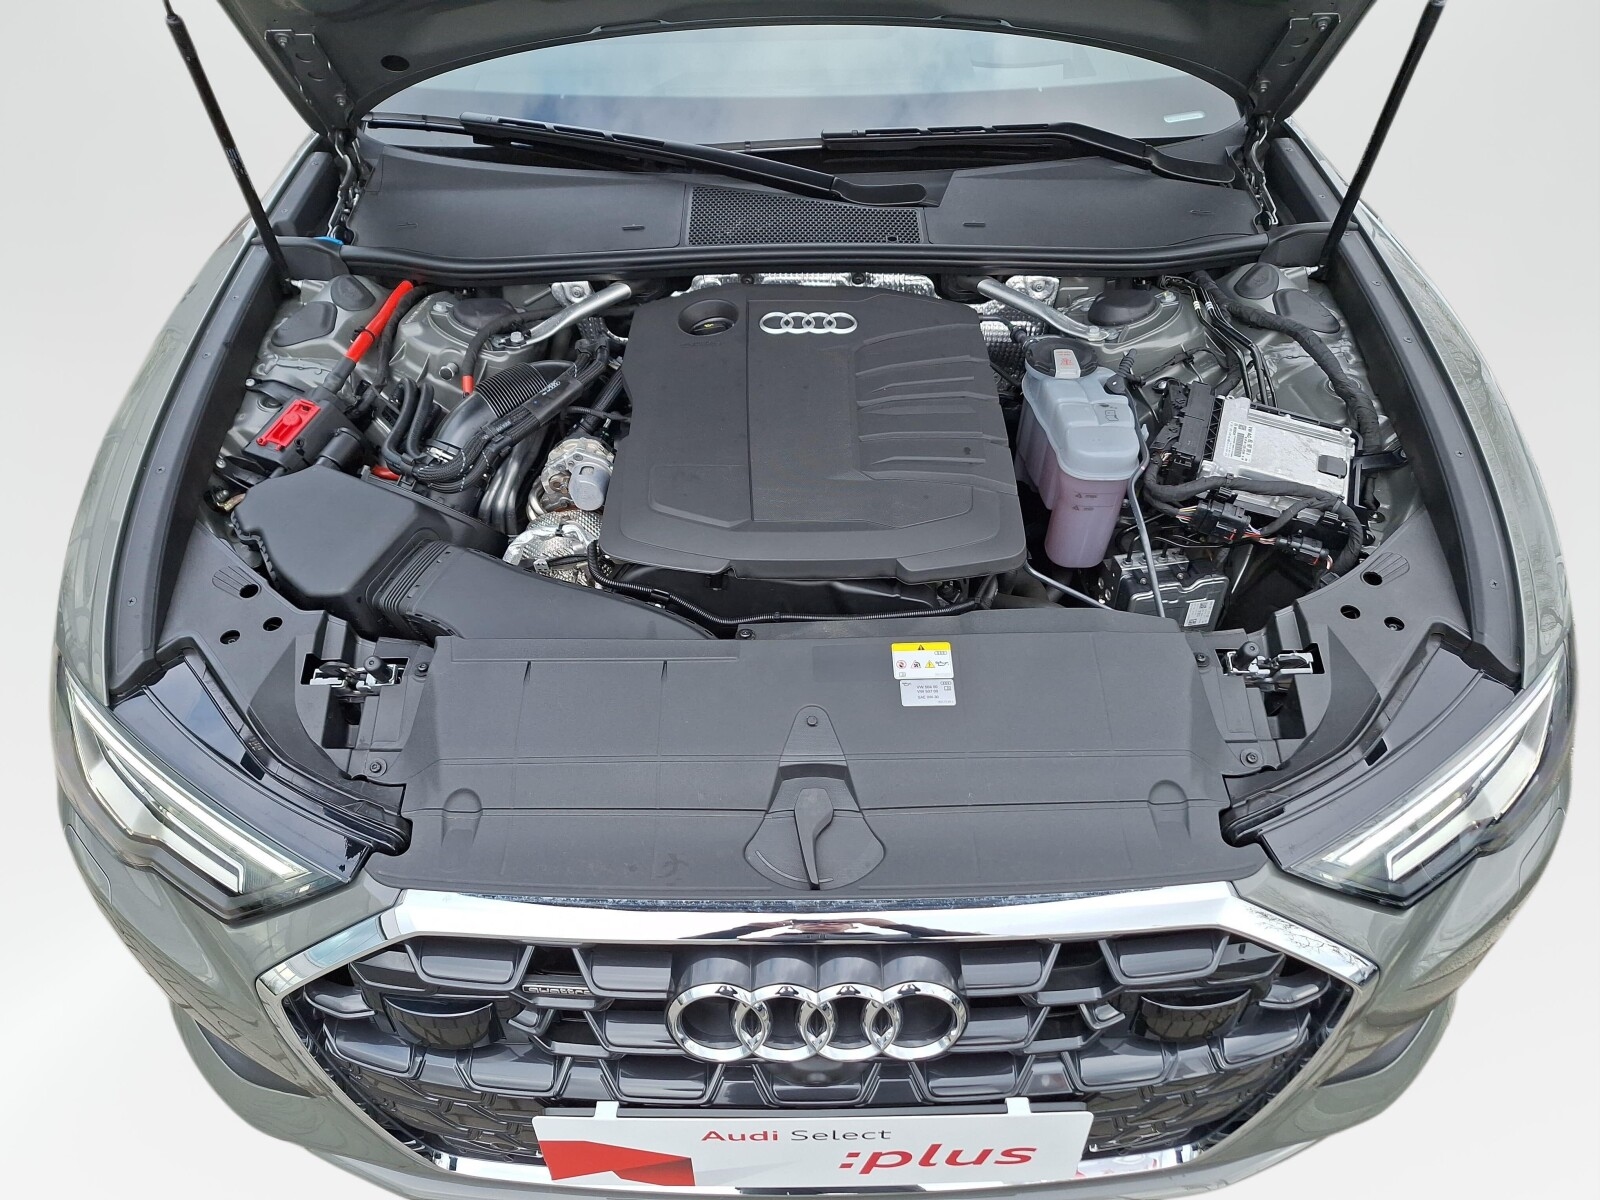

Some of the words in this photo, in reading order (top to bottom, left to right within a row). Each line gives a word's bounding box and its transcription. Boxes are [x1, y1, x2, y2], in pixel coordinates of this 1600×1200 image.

[701, 1130, 778, 1141] Audi
[790, 1129, 892, 1142] Select
[839, 1143, 1038, 1175] :plus
